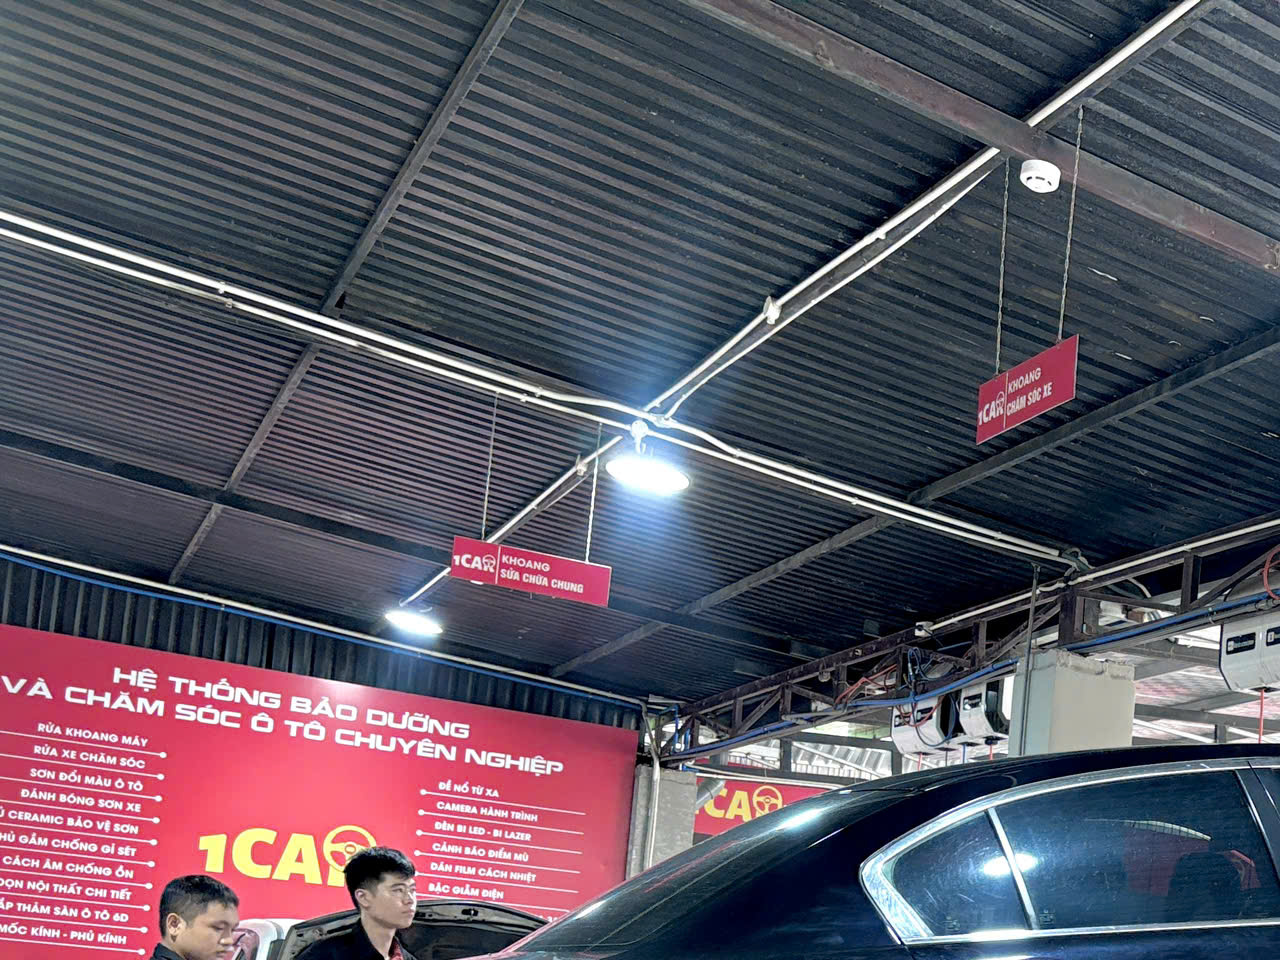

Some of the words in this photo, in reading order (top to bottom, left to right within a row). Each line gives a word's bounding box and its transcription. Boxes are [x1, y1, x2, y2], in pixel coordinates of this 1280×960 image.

[1008, 368, 1041, 394] KHOANG
[1043, 382, 1053, 399] XE
[502, 555, 550, 572] KHOANG
[500, 568, 520, 581] SỬA
[522, 572, 548, 586] CHỮA
[551, 579, 584, 593] CHUNG
[113, 668, 158, 691] HỆ
[169, 677, 281, 709] THỐNG
[290, 697, 357, 720] BẢO
[366, 711, 470, 739] DƯỠNG
[1, 675, 53, 699] VÀ
[65, 686, 164, 717] CHĂM
[175, 704, 241, 729] SÓC
[251, 713, 274, 733] Ô
[284, 720, 326, 741] TÔ
[334, 729, 456, 761] CHUYÊN
[464, 748, 564, 776] NGHIỆP
[37, 722, 62, 735] RỬA
[65, 726, 118, 743] KHOANG
[121, 733, 148, 748] MÁY
[33, 744, 58, 757] RỬA
[62, 749, 77, 760] XE
[80, 750, 117, 766] CHĂM
[120, 755, 146, 769] SÓC
[30, 768, 56, 780] SƠN
[58, 770, 82, 783] ĐỔI
[84, 773, 112, 788] MÀU
[115, 777, 125, 789] Ô
[127, 780, 143, 791] TÔ
[20, 788, 57, 801] ĐÁNH
[59, 793, 95, 807] BÓNG
[98, 798, 123, 811] SƠN
[126, 802, 141, 812] XE
[471, 786, 484, 797] TỪ
[485, 789, 499, 798] XA
[436, 801, 478, 815] CAMERA
[480, 805, 509, 818] HÀNH
[511, 809, 538, 822] TRÌNH
[8, 810, 64, 825] CERAMIC
[67, 816, 93, 829] BẢO
[97, 820, 110, 833] VỆ
[113, 822, 139, 835] SƠN
[434, 821, 455, 833] ĐÈN
[457, 825, 466, 834] BI
[468, 826, 485, 836] LED
[493, 829, 502, 838] BI
[504, 830, 531, 842] LAZER
[51, 838, 98, 852] CHỐNG
[101, 842, 115, 855] GỈ
[117, 845, 137, 857] SÉT
[432, 842, 462, 854] CẢNH
[464, 846, 486, 857] BÁO
[488, 849, 511, 861] ĐIỂM
[513, 851, 529, 862] MÙ
[2, 855, 40, 868] CÁCH
[43, 858, 63, 871] ÂM
[65, 861, 112, 876] CHỐNG
[430, 862, 452, 873] DÁN
[454, 865, 476, 876] FILM
[478, 866, 508, 879] CÁCH
[510, 870, 536, 884] NHIỆT
[27, 880, 49, 893] NỘI
[53, 883, 82, 896] THẤT
[85, 887, 106, 898] CHI
[109, 887, 132, 901] TIẾT
[428, 883, 450, 895] BẬC
[482, 889, 504, 900] ĐIỆN
[16, 902, 50, 915] THẢM
[54, 905, 78, 918] SÀN
[81, 907, 91, 919] Ô
[94, 909, 110, 921] TÔ
[112, 912, 129, 923] 6D
[31, 926, 60, 939] KÍNH
[70, 930, 94, 942] PHỦ
[98, 931, 127, 945] KÍNH
